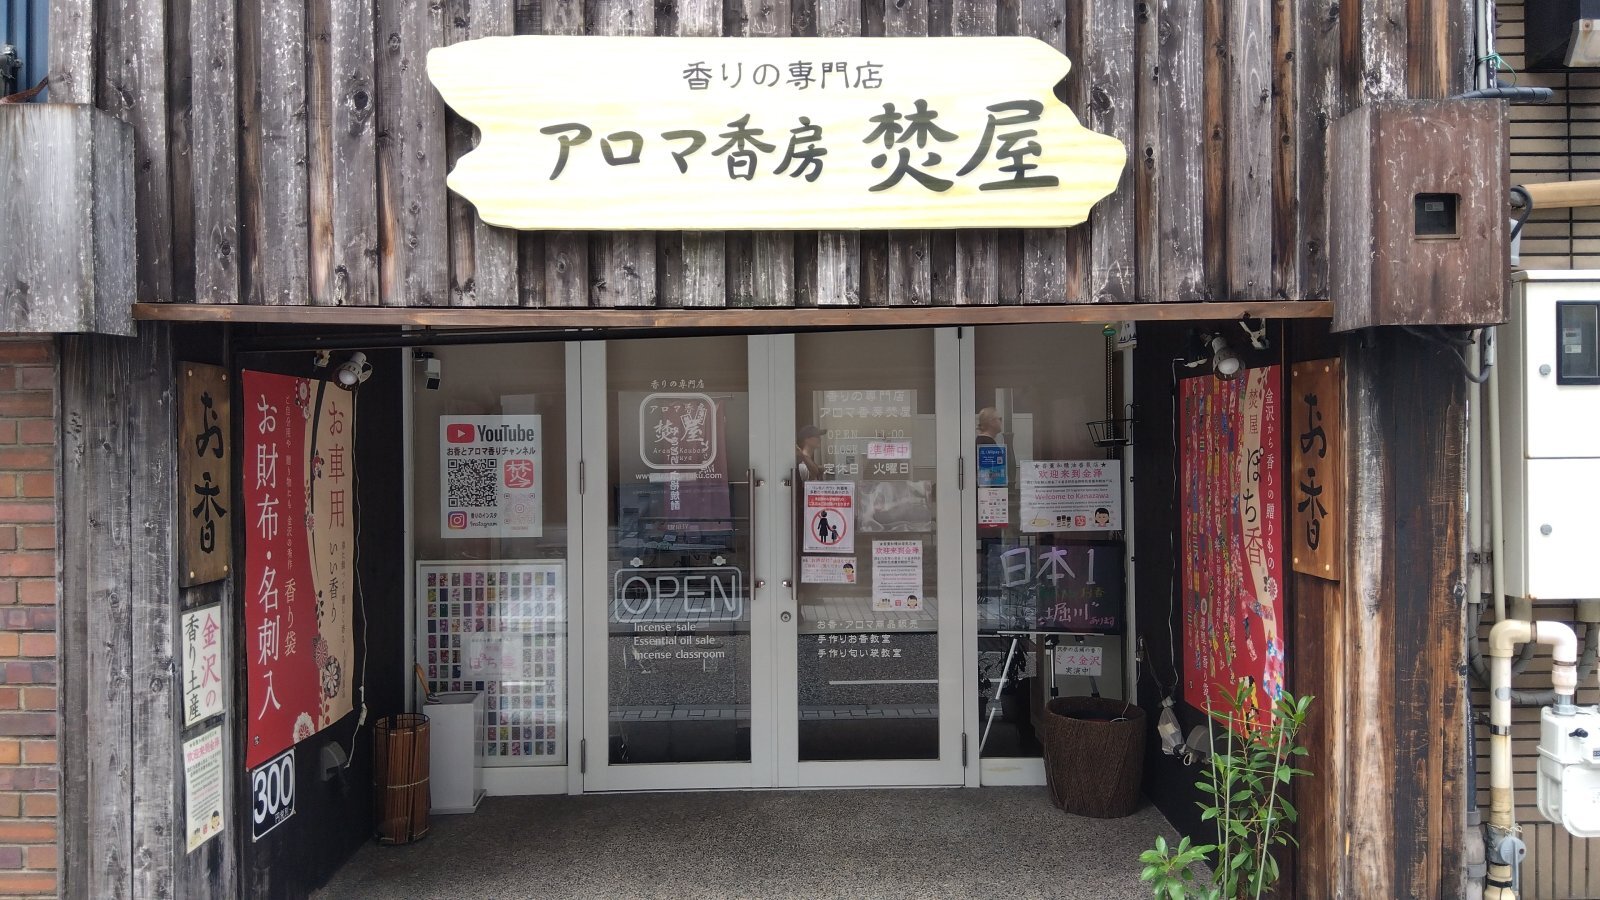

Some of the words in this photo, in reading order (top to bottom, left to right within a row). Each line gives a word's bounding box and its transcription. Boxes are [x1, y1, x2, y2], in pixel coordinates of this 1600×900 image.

[683, 60, 885, 91] 香りの専門店
[538, 112, 826, 184] アロマ香房
[861, 99, 1060, 194] 焚屋
[651, 379, 705, 389] 香りの専門店
[826, 391, 905, 402] 香りの専門店
[1248, 387, 1259, 435] 焚屋
[477, 424, 535, 442] YouTube
[827, 429, 858, 440] OPEN
[447, 447, 536, 456] お香とアロマ香りチャンネル
[869, 444, 908, 456] 準備中
[328, 401, 346, 530] お車用
[823, 463, 859, 475] 定休日
[873, 463, 909, 474] 火曜日
[1298, 392, 1329, 550] お香
[192, 391, 228, 554] お香
[1265, 388, 1275, 570] 金沢から香りの贈りもの
[470, 521, 498, 529] Instagram
[256, 394, 281, 720] お財布・名刺入
[622, 575, 736, 614] OPEN
[634, 622, 672, 631] Incense
[676, 622, 697, 631] sale
[817, 619, 918, 630] お香・アロマ商品販売
[634, 636, 677, 645] Essential
[680, 635, 692, 645] oil
[695, 635, 716, 645] sale
[817, 634, 891, 644] 手作りお香教室
[634, 650, 672, 659] Incense
[675, 649, 725, 659] classroom
[817, 648, 902, 658] 手作り匂い袋教室
[201, 613, 221, 708] 金沢の
[1056, 655, 1102, 666] ミス金沢
[185, 614, 200, 721] 香り土産
[254, 756, 294, 824] 300
